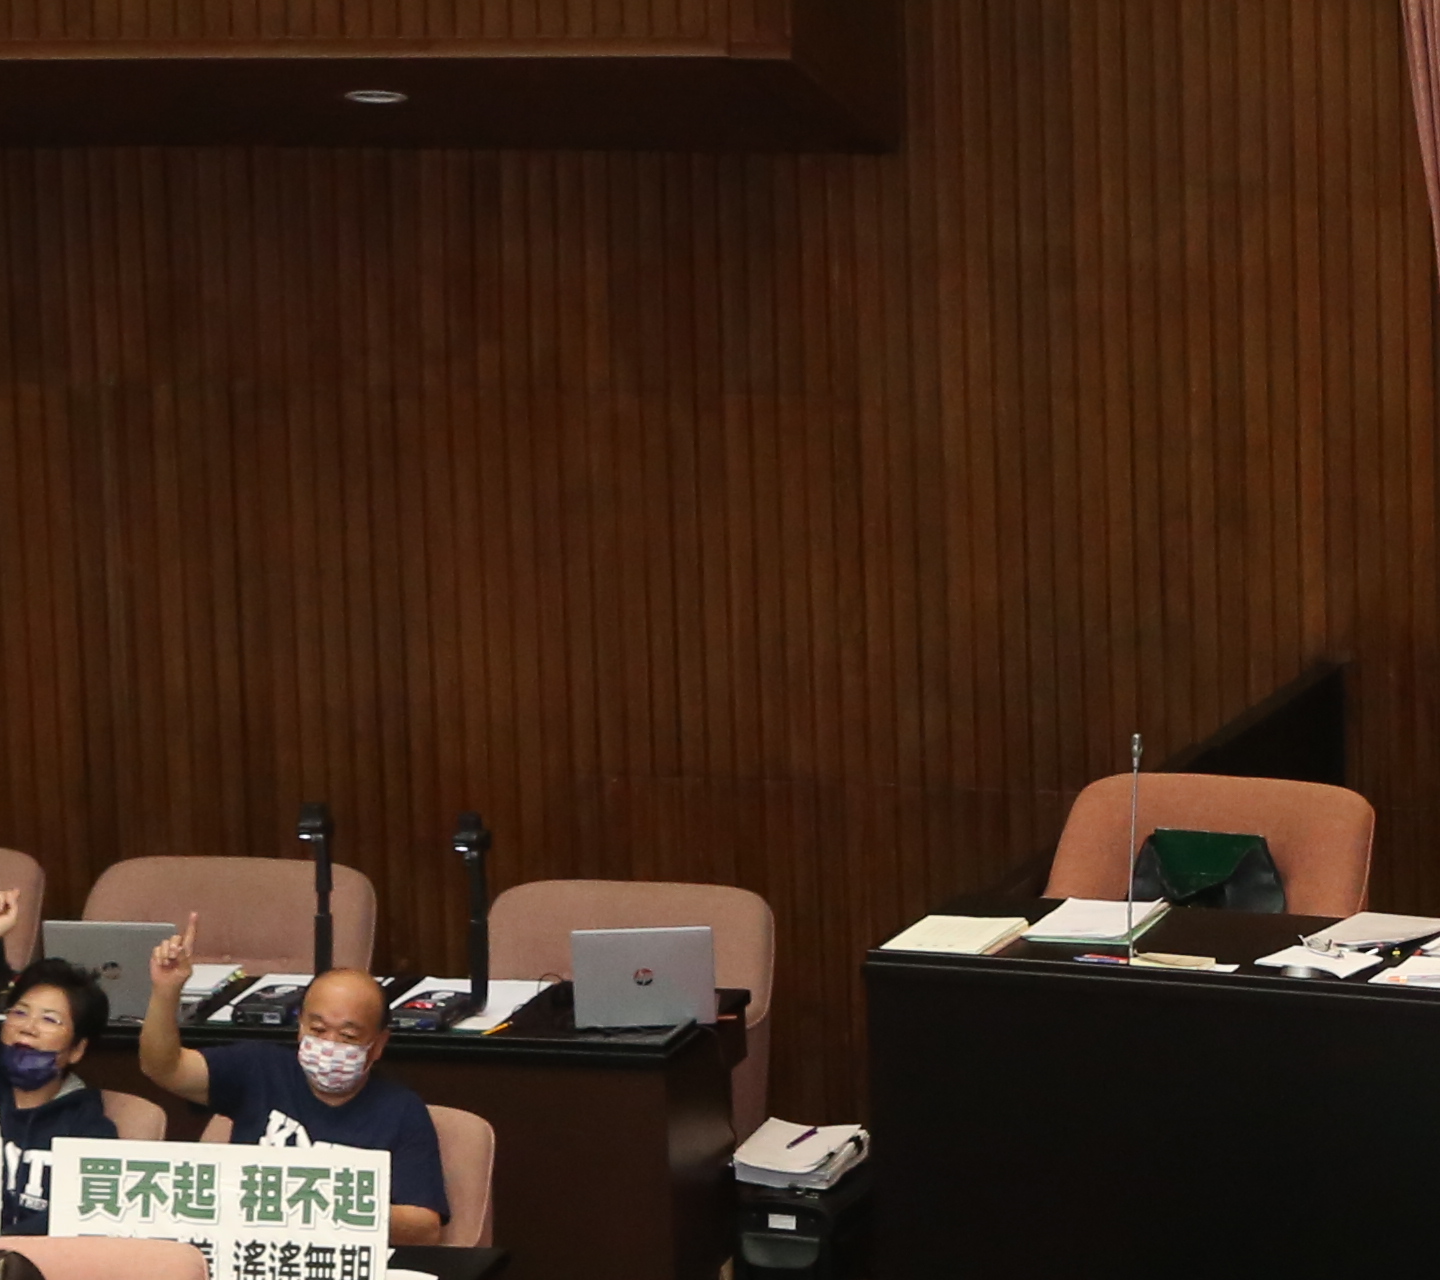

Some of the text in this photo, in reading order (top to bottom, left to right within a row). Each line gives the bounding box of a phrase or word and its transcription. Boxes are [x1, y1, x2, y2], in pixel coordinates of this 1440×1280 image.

[78, 1157, 376, 1226] 買不起 租不起
